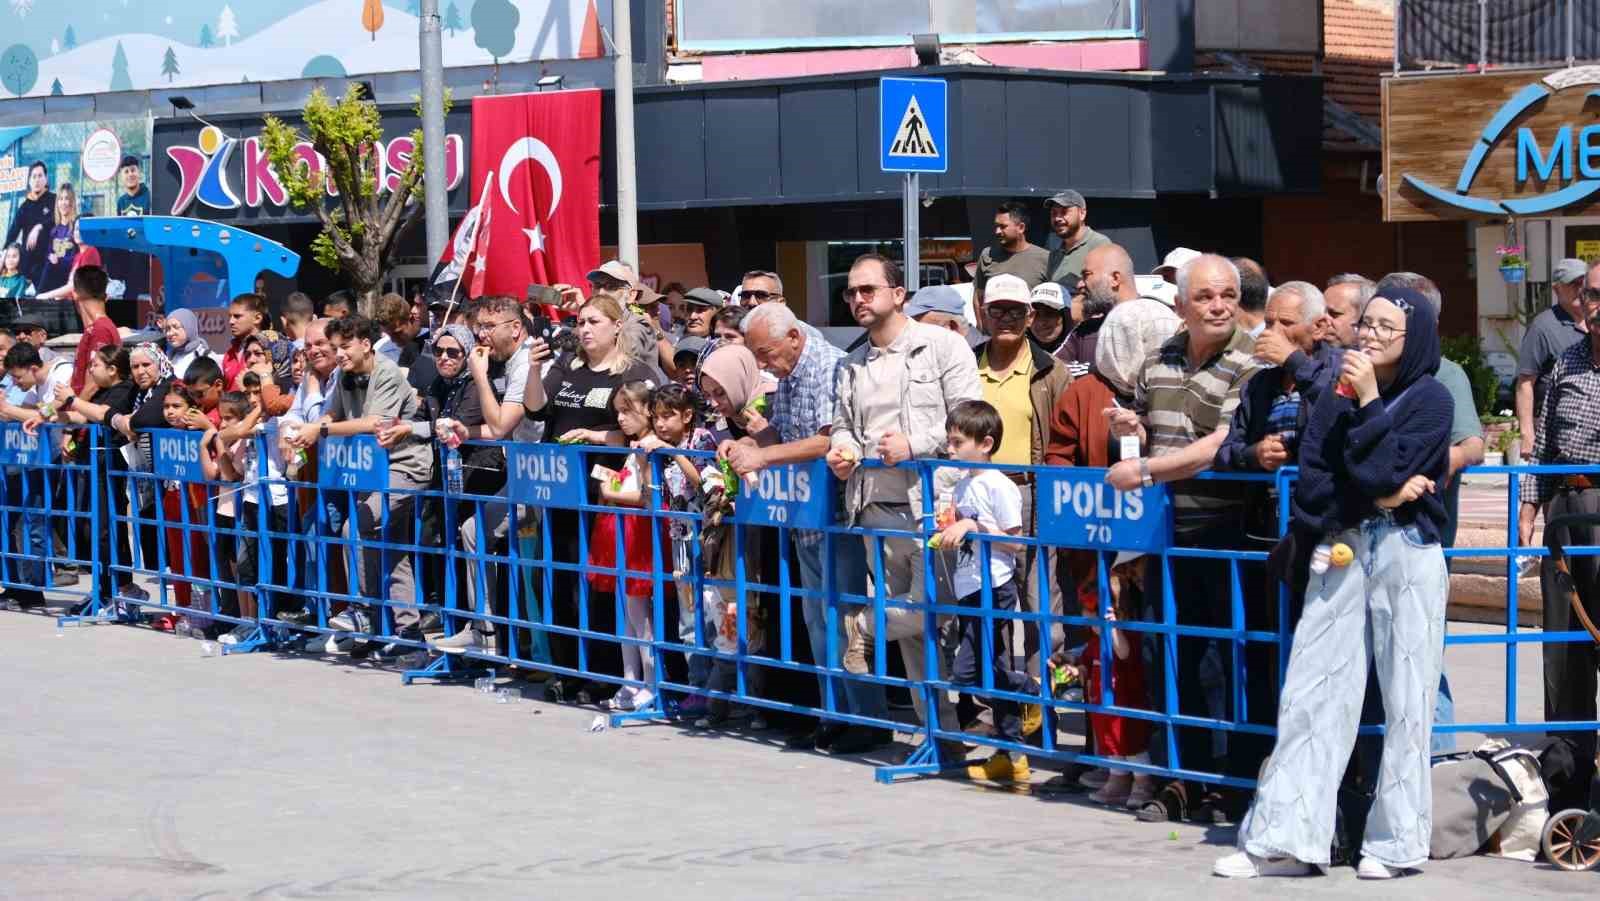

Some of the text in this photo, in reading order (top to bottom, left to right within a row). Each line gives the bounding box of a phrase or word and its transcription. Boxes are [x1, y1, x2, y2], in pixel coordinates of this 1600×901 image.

[16, 453, 28, 464] 70
[516, 449, 569, 483] POLİS
[173, 464, 186, 477] 70
[342, 472, 356, 487] 70
[535, 486, 551, 501] 70
[767, 504, 788, 523] 70
[1085, 523, 1112, 544] 70
